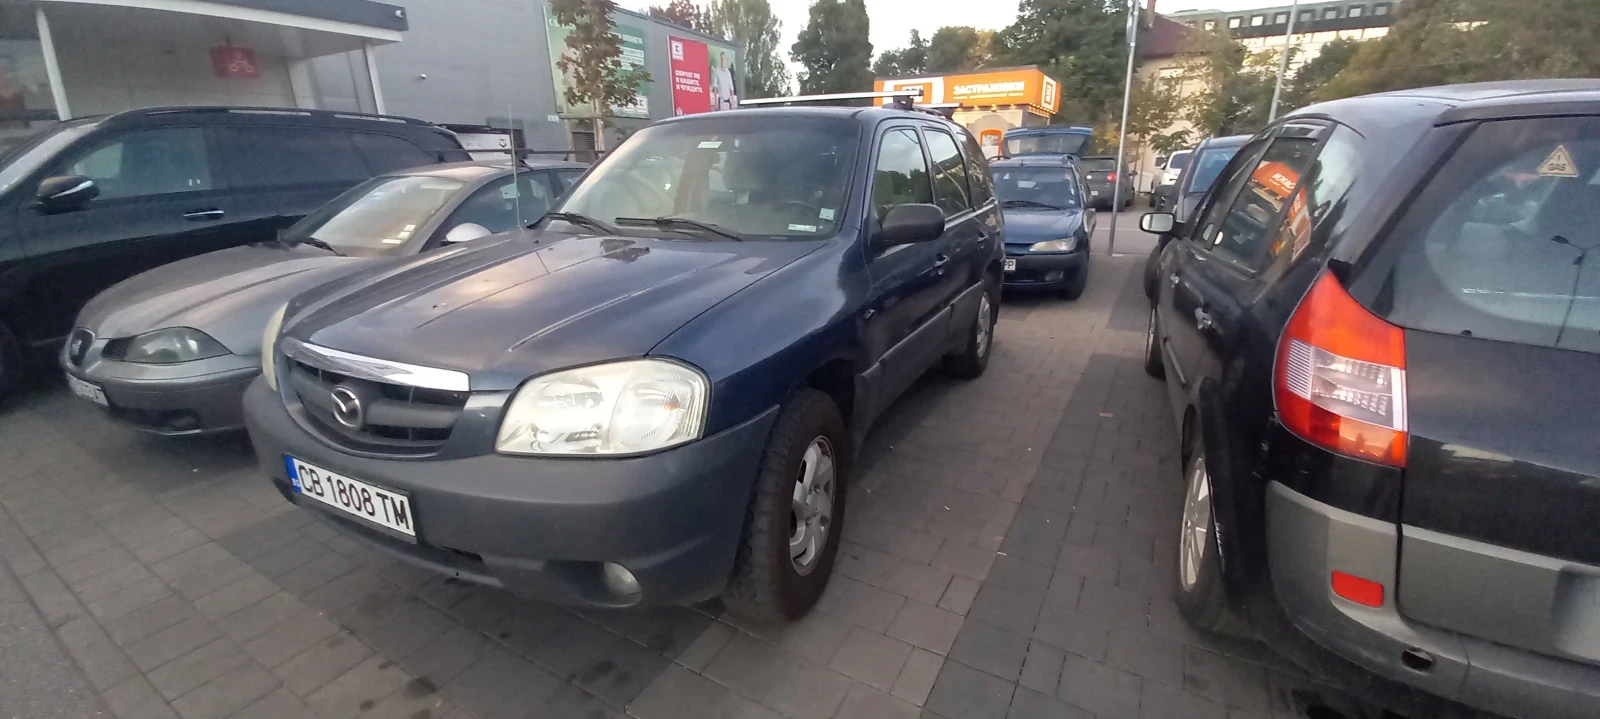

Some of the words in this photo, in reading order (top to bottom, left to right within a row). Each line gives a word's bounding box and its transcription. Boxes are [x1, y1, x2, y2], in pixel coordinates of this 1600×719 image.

[953, 81, 1025, 95] ЗАСТРАХОВКИ
[1548, 163, 1566, 172] GAS
[298, 464, 324, 498] CB
[326, 475, 376, 517] 1808
[376, 491, 410, 530] TM
